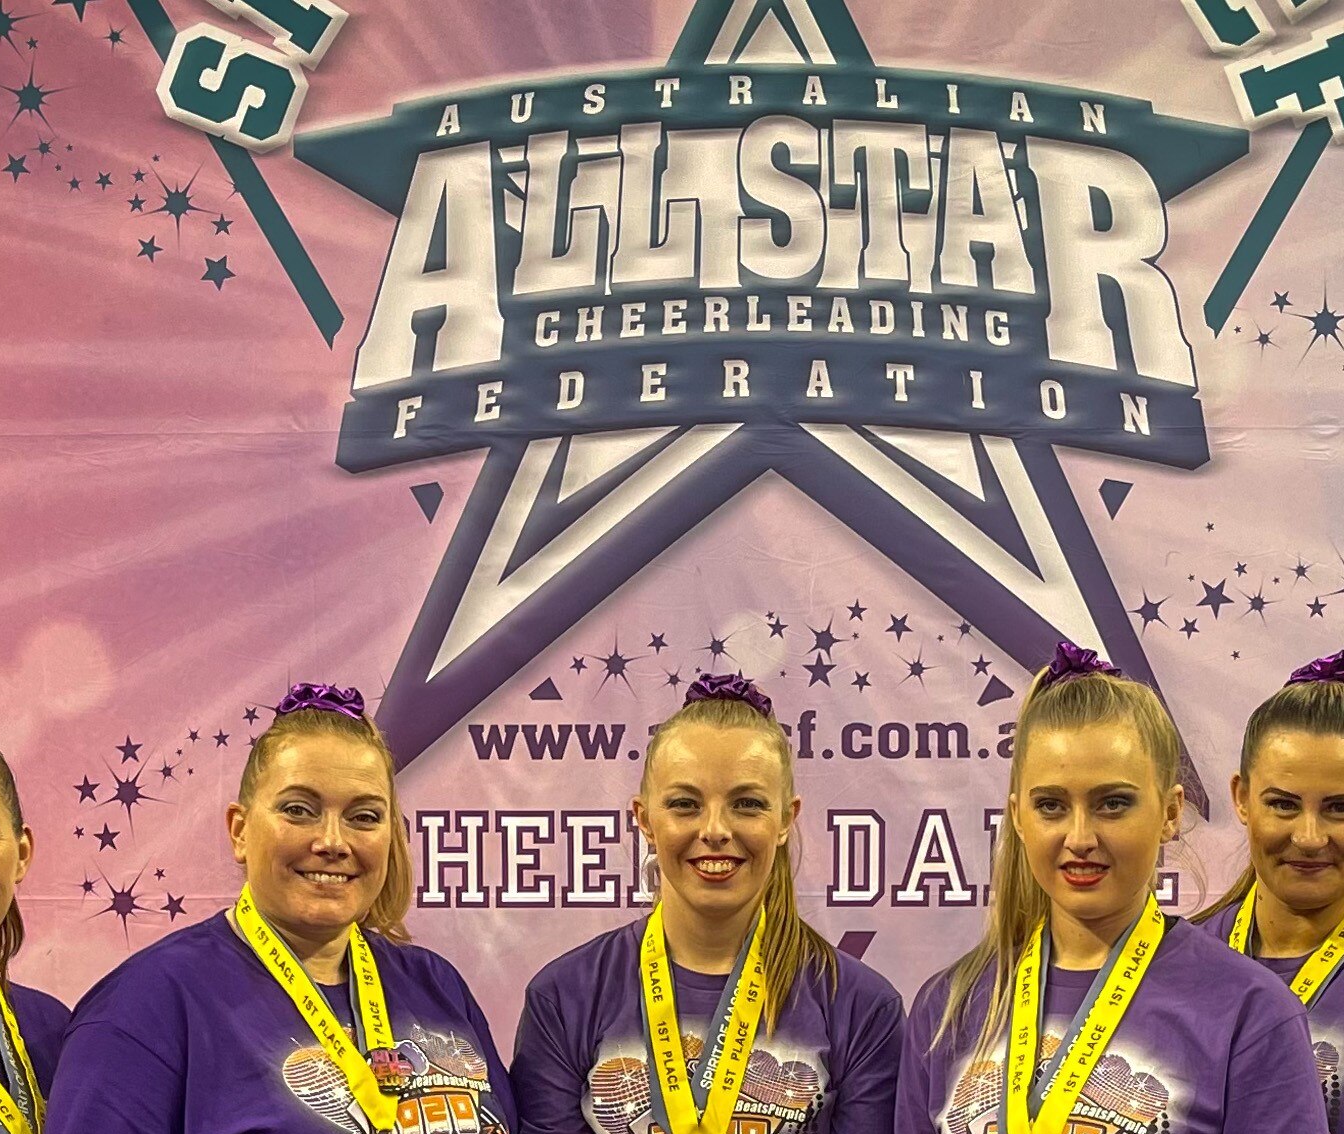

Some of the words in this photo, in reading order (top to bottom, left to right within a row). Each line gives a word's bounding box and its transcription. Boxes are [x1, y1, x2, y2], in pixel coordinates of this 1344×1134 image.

[436, 75, 1111, 139] AUSTRALIAN
[534, 295, 1014, 349] CHEERLEADING
[394, 361, 1152, 440] FEDERATION
[469, 710, 1018, 761] www.f.com.a
[404, 809, 660, 909] HEE
[646, 933, 657, 954] 1ST
[1320, 944, 1338, 964] 1ST
[255, 927, 269, 946] 1ST
[269, 947, 296, 985] PLACE
[302, 995, 319, 1016] 1ST
[318, 1019, 346, 1058] PLACE
[362, 968, 374, 987] 1ST
[648, 961, 664, 1003] PLACE
[1021, 966, 1033, 1008] PLACE
[369, 1000, 383, 1035] PLACE
[1063, 1072, 1080, 1094] 1ST
[1079, 1024, 1107, 1066] PLACE
[1109, 986, 1126, 1007] 1ST
[1124, 940, 1150, 980] PLACE
[1152, 905, 1163, 925] 1S
[657, 1020, 671, 1044] 1ST
[722, 1069, 737, 1092] 1ST
[733, 1021, 750, 1061] PLACE
[746, 980, 761, 1004] 1ST
[1018, 1026, 1029, 1046] 1ST
[662, 1050, 680, 1092] PLACE
[700, 1044, 722, 1090] SPIRIT
[1012, 1054, 1025, 1094] PLACE
